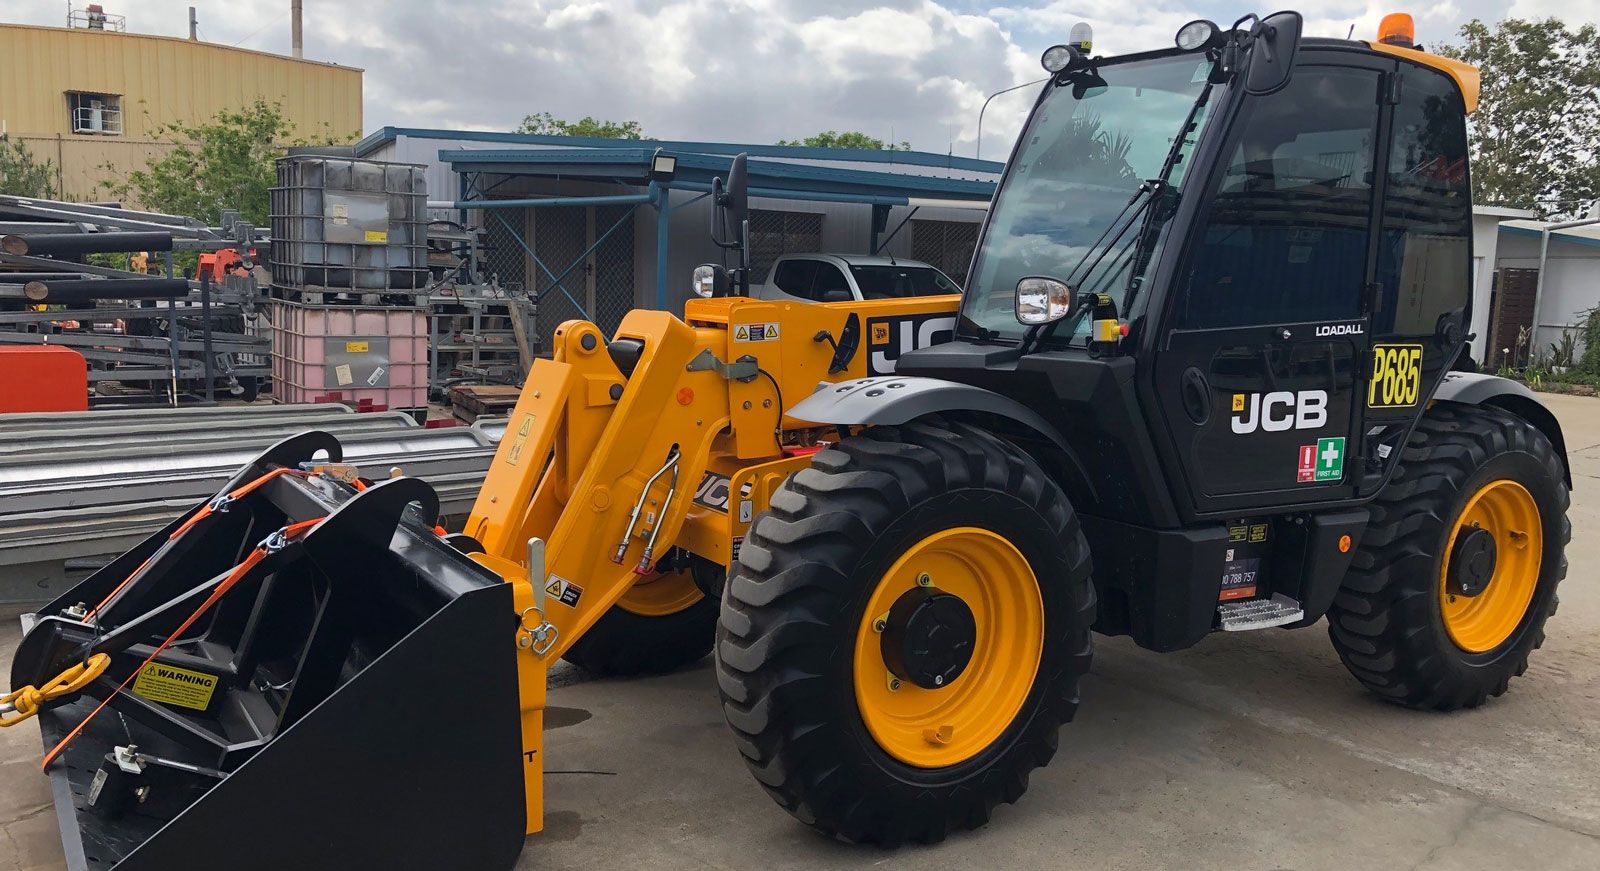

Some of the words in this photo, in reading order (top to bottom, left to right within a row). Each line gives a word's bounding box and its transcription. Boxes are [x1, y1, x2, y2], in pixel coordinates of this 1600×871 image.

[872, 317, 957, 374] JC
[1316, 324, 1364, 337] LOADALL
[1370, 348, 1421, 405] P685
[1231, 389, 1328, 434] JCB
[1243, 571, 1256, 582] 757
[158, 668, 213, 688] WARNING
